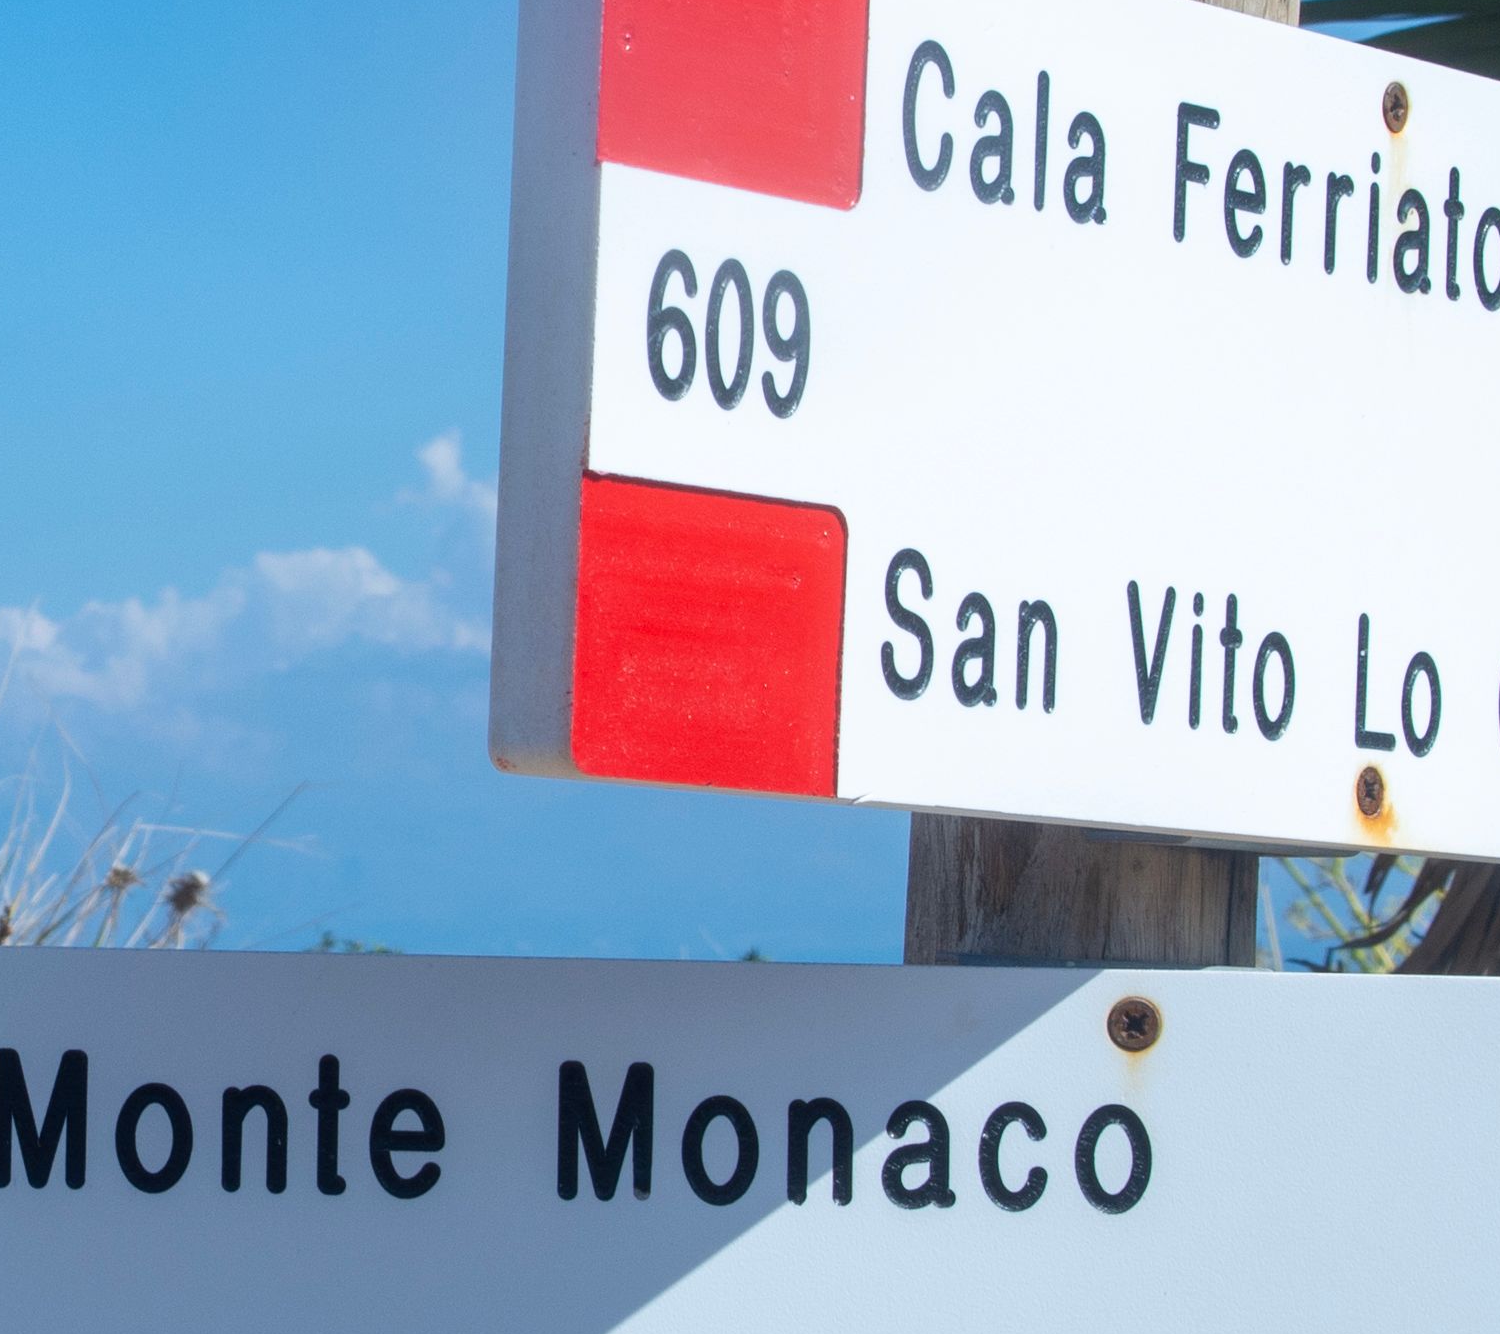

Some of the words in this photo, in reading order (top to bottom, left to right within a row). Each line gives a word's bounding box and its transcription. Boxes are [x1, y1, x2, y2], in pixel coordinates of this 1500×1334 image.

[901, 39, 1108, 226] Cala
[646, 248, 812, 419] 609
[879, 547, 1059, 715] San
[1125, 579, 1297, 742] Vito
[1353, 611, 1443, 759] Lo
[555, 1059, 1153, 1212] Monaco
